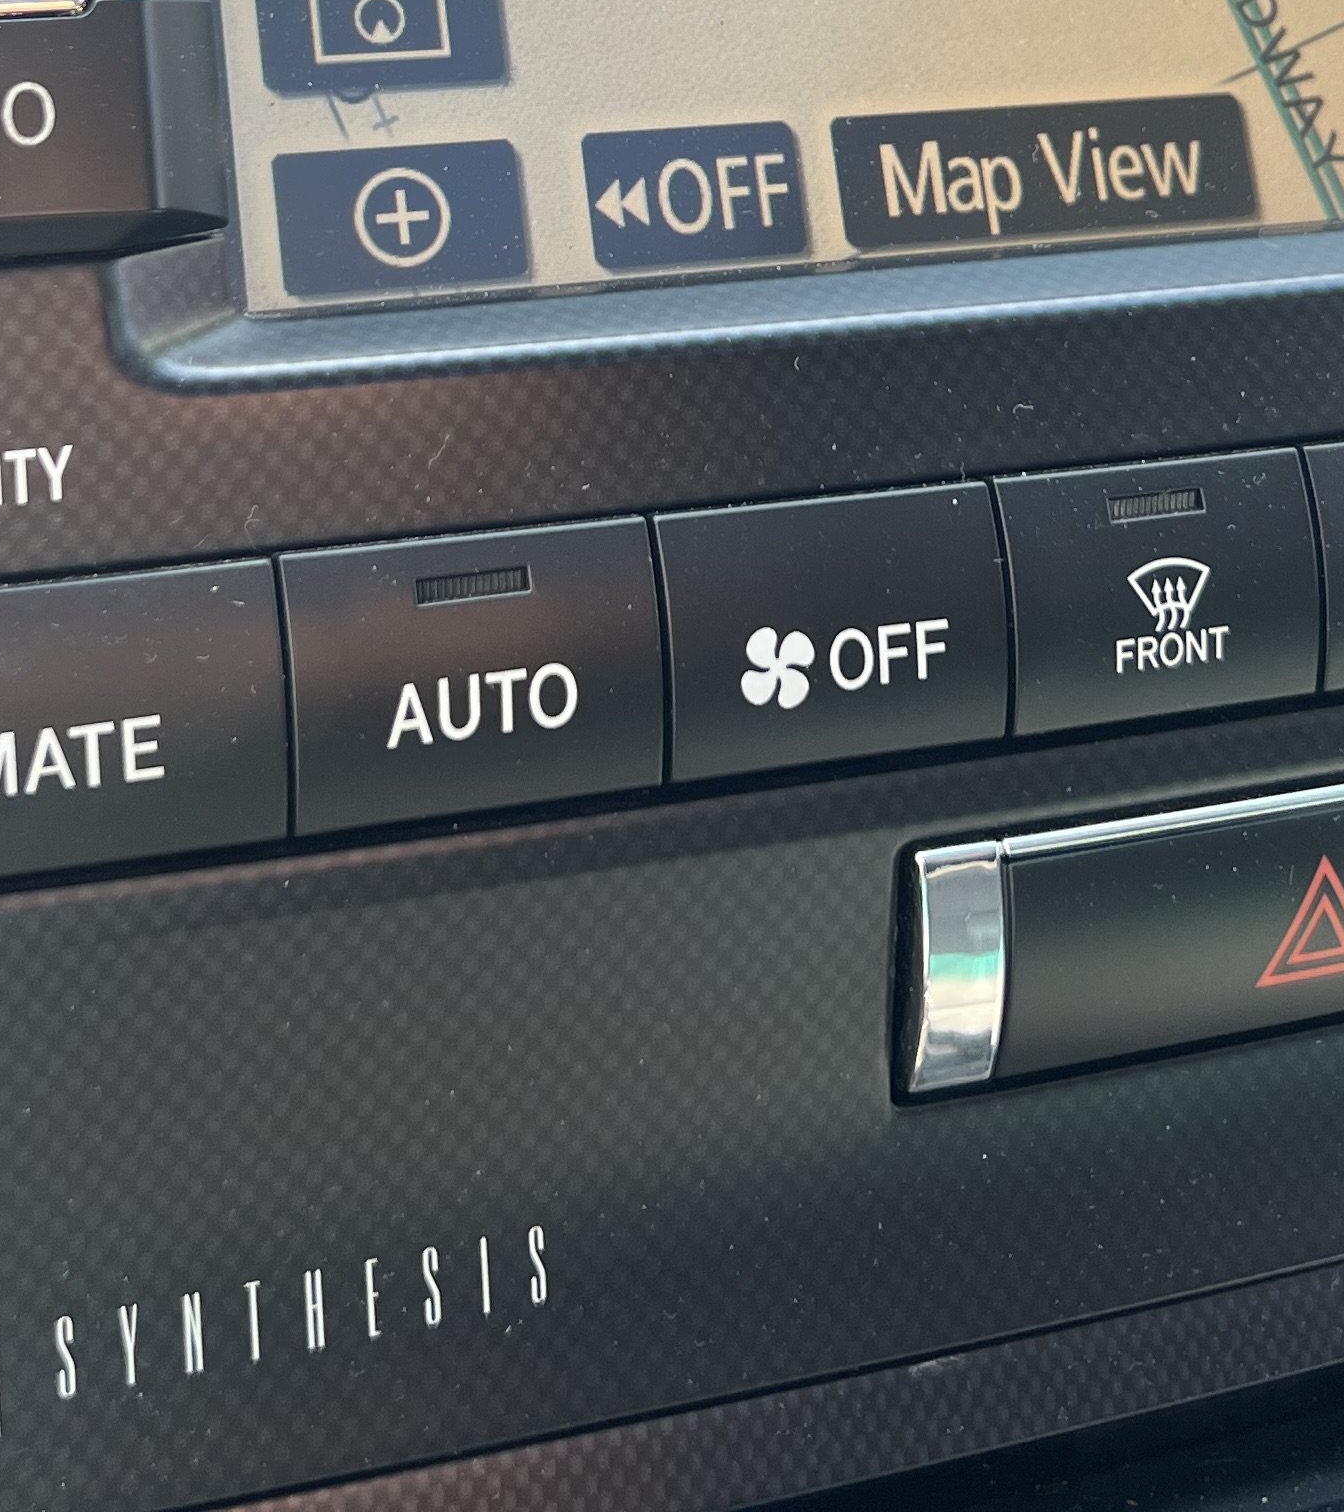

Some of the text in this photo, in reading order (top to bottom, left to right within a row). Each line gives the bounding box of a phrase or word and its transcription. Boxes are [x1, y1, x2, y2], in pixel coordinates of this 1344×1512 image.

[658, 152, 790, 235] OFF
[878, 131, 1204, 236] Map View
[829, 618, 950, 692] OFF
[1115, 625, 1232, 674] FRONT
[386, 661, 579, 750] AUTO
[55, 1223, 550, 1401] SYNTHESIS
